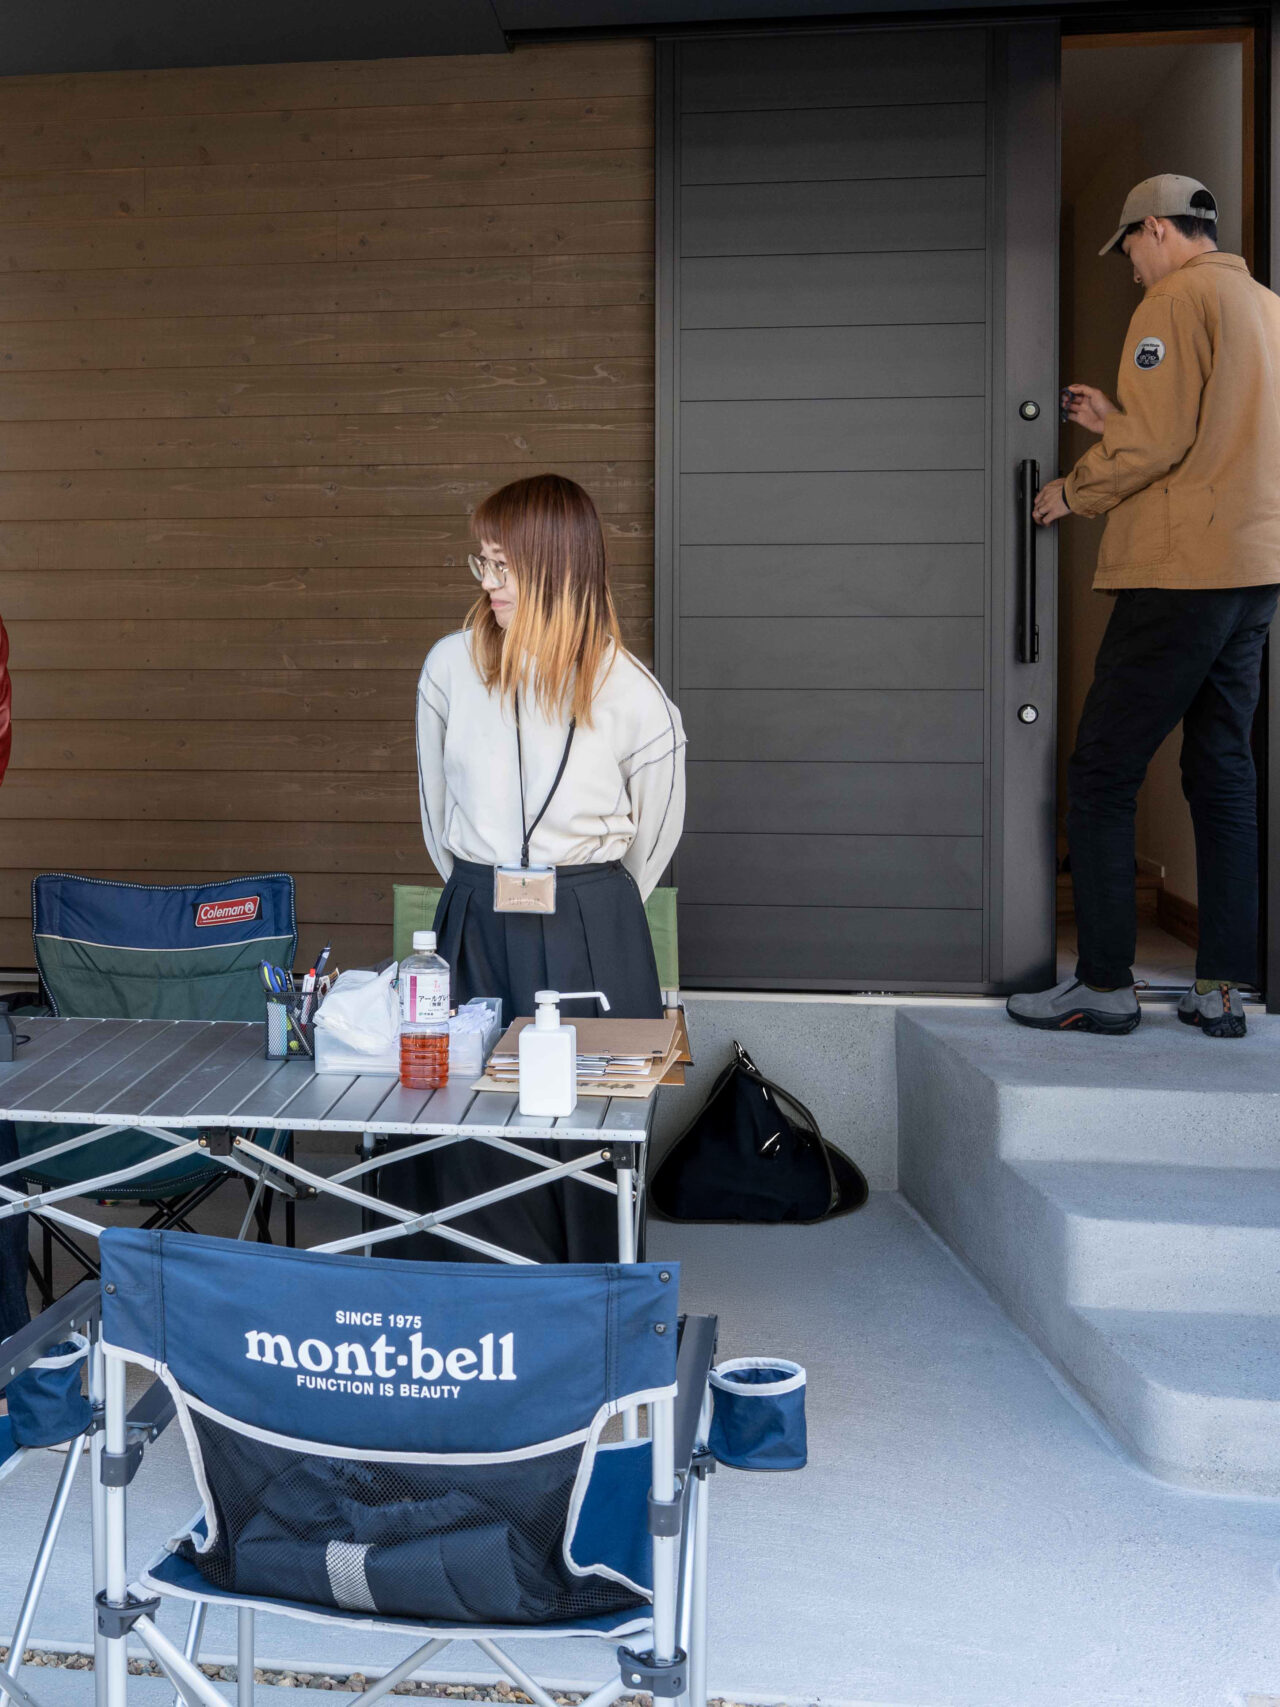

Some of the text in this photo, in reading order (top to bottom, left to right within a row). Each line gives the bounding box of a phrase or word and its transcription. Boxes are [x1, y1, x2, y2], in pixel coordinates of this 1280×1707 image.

[200, 905, 245, 920] Coleman
[335, 1310, 422, 1329] SINCE 1975
[296, 1374, 461, 1399] FUNCTION IS BEAUTY
